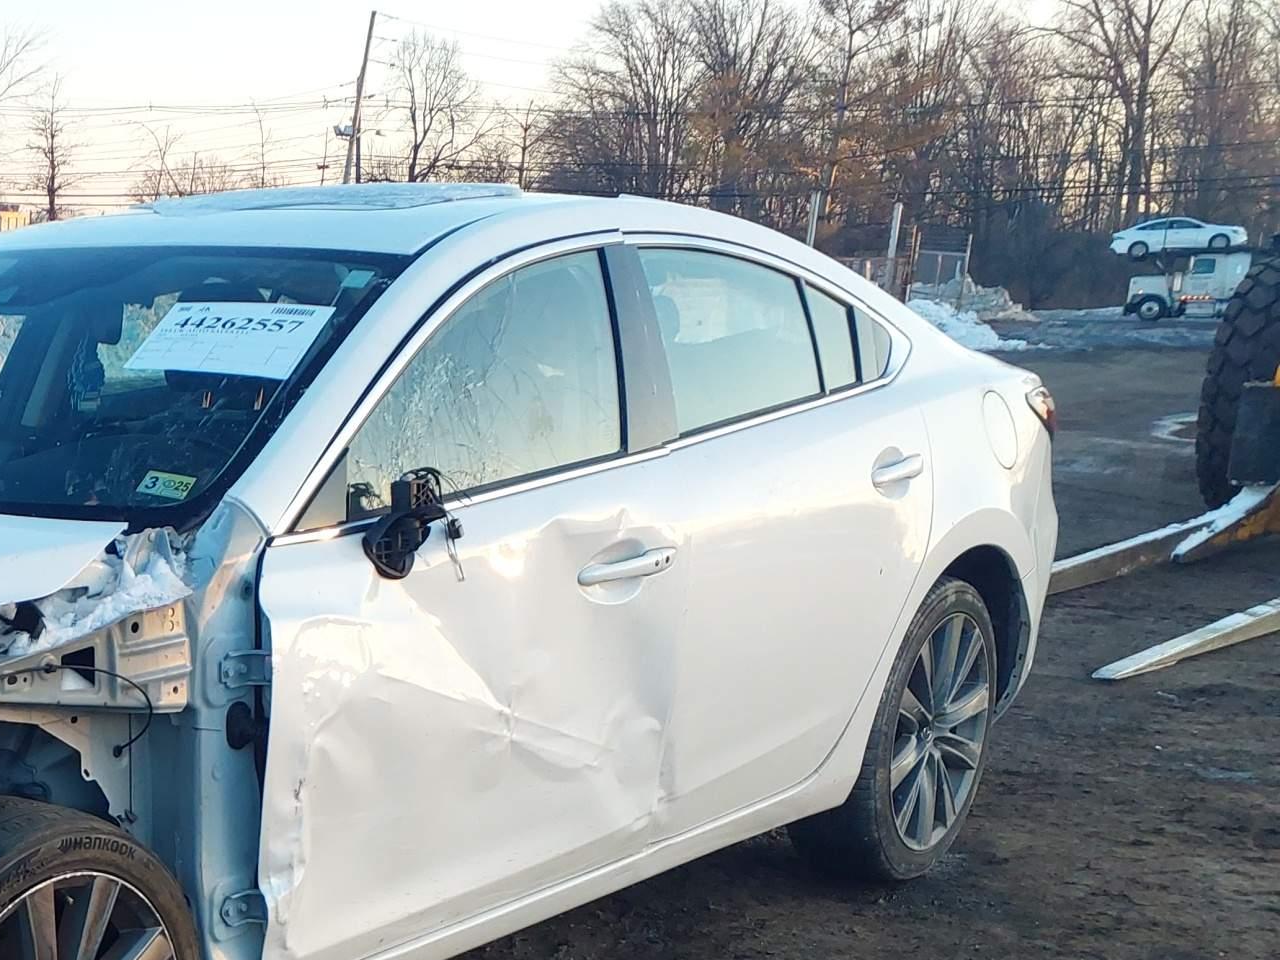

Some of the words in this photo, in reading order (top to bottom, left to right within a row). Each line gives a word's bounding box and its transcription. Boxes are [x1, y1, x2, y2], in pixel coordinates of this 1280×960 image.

[174, 315, 305, 333] 44262557
[145, 476, 160, 489] 3
[174, 480, 191, 492] 25
